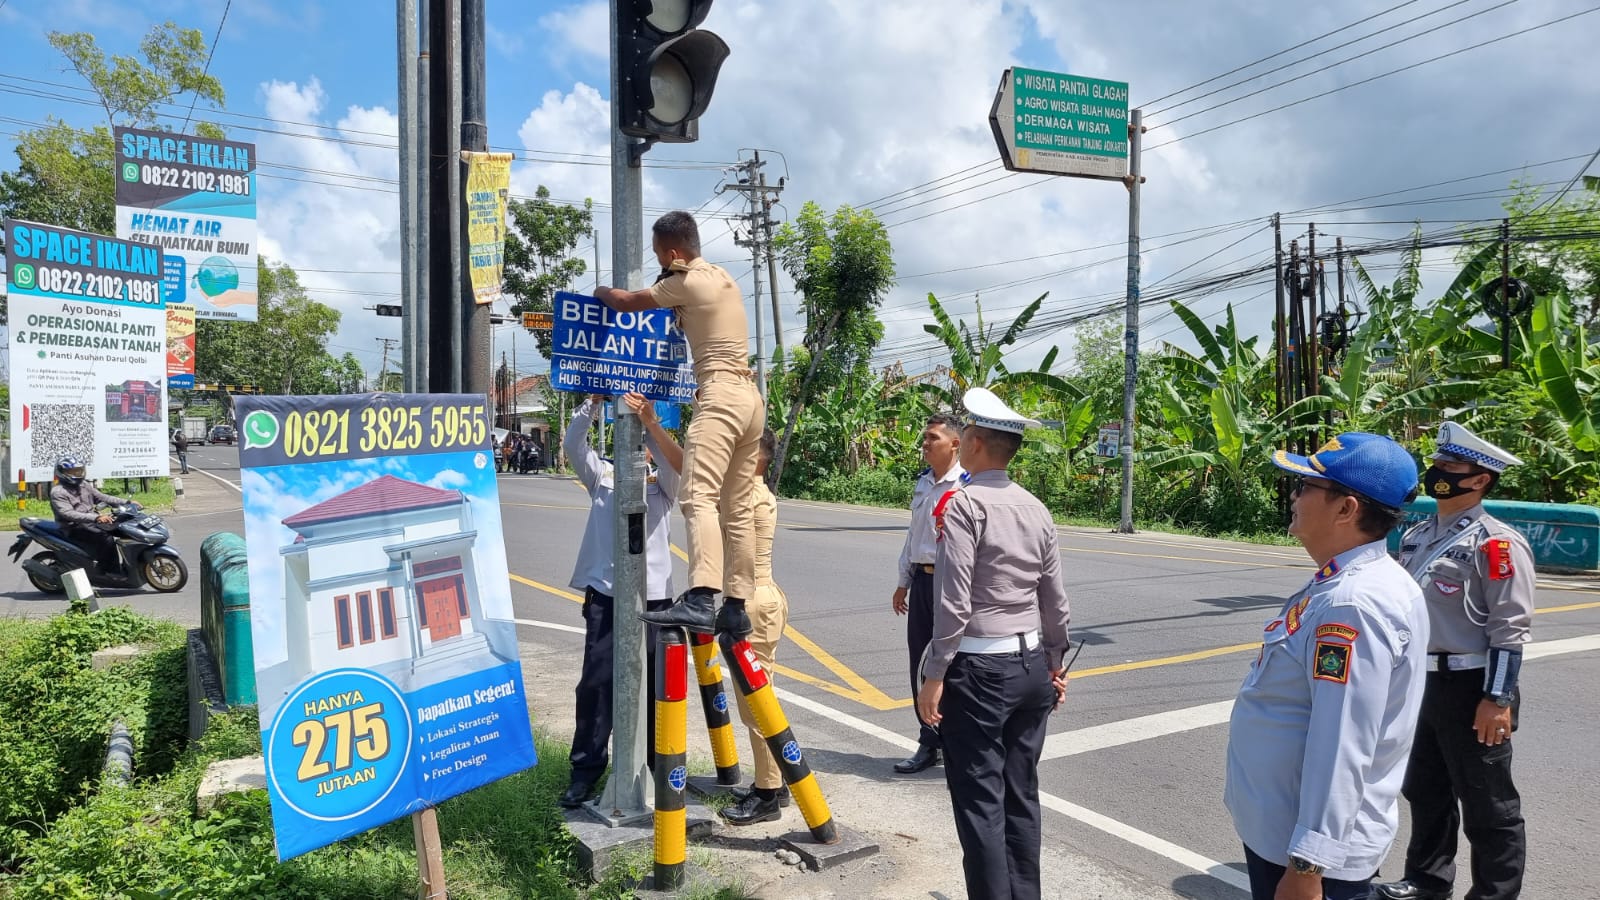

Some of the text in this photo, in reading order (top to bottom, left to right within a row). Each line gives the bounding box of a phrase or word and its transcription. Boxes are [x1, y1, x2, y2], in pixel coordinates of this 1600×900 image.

[1024, 74, 1127, 102] WISATA PANTAI GLAGAH
[1024, 97, 1127, 120] AGRO WISATA BUAH NAGA
[1024, 114, 1110, 135] DERMAGA WISATA
[122, 133, 249, 171] SPACE IKLAN
[1024, 131, 1127, 153] PELABUHAN PERIKANAN TANJUNG ADIKARTO
[142, 164, 249, 196] 0822 2102 1981
[131, 213, 222, 237] HEMAT AIR
[13, 225, 160, 276] SPACE IKLAN
[216, 239, 250, 256] BUMI
[38, 266, 160, 305] 0822 2102 1981
[61, 303, 122, 318] Ayo Donasi
[562, 300, 655, 334] BELOK
[27, 313, 156, 337] OPERASIONAL PANTI
[16, 330, 161, 353] & PEMBEBASAN TANAH
[561, 328, 673, 361] JALAN TE
[50, 351, 73, 360] Panti
[74, 353, 105, 362] Asuhan
[128, 356, 147, 365] Qolbi
[560, 358, 610, 375] GANGGUAN
[559, 373, 697, 398] HUB. TELP/SMS (0274) 8002
[283, 405, 487, 458] 0821 3825 5955
[1441, 549, 1473, 562] OLRI
[304, 690, 364, 717] HANYA
[417, 679, 516, 725] Dapatkan Segera!
[427, 712, 500, 743] Lokasi Strategis
[292, 702, 391, 782] 275
[430, 730, 500, 762] Legalitas Aman
[431, 753, 488, 780] Free Design
[315, 766, 376, 798] JUTAAN
